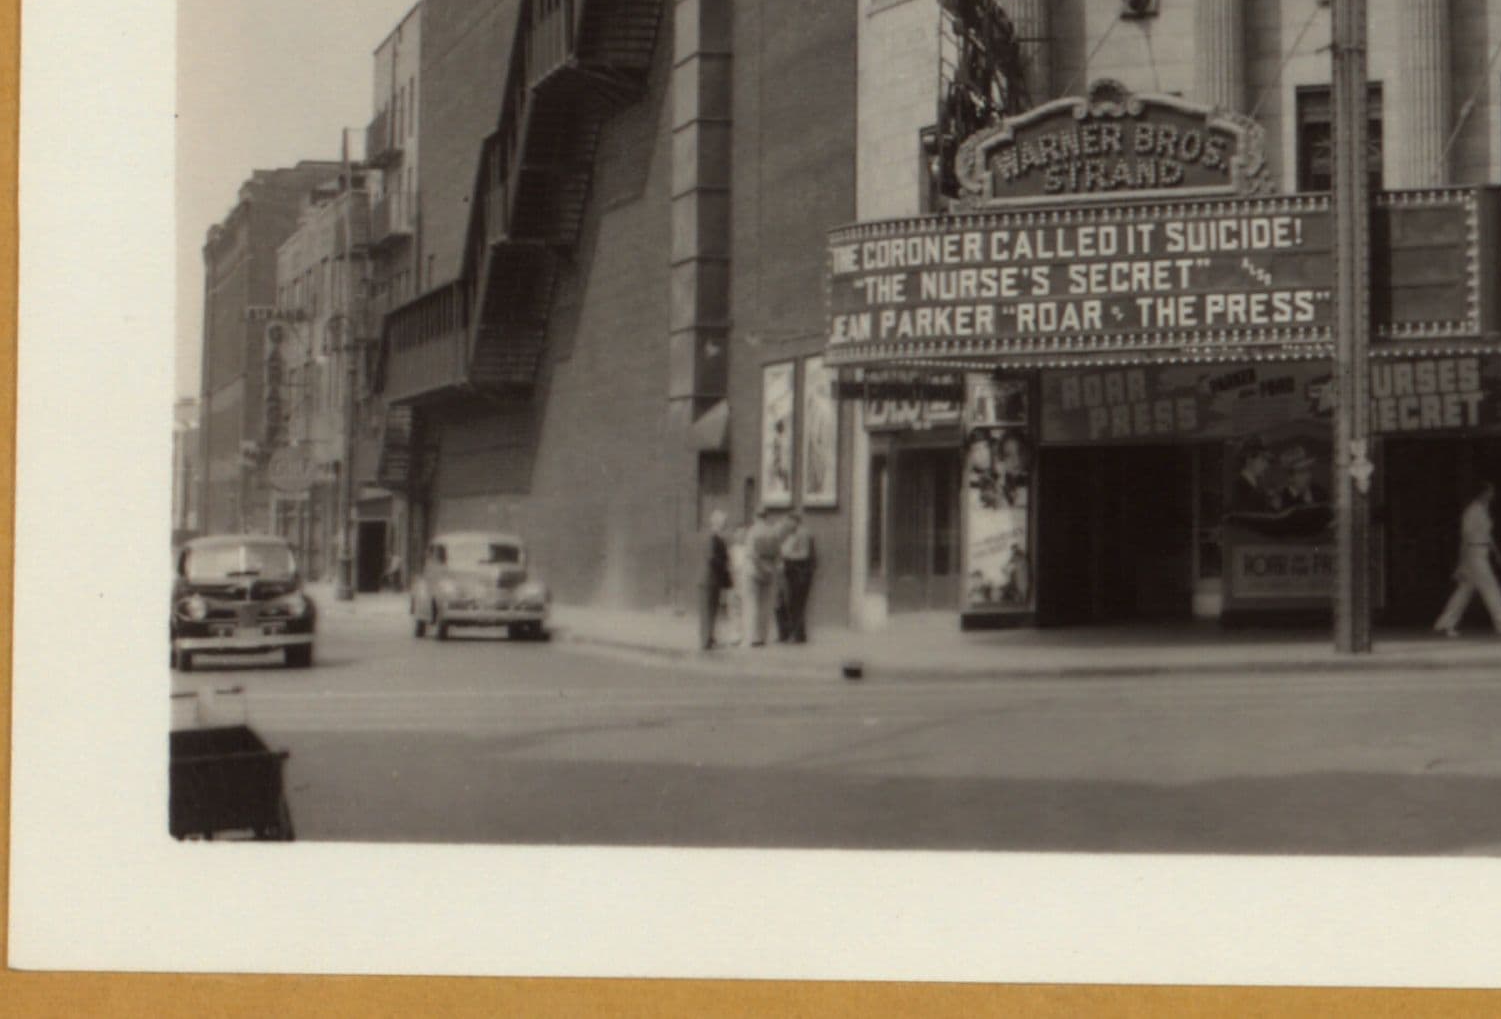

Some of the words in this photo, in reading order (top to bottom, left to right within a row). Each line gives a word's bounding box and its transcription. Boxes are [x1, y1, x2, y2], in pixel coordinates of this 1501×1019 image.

[993, 123, 1122, 179] WARNER
[1045, 159, 1182, 191] STRAND
[862, 232, 984, 270] CORONER
[990, 225, 1118, 262] CALLED
[1126, 223, 1156, 255] IT
[1165, 217, 1303, 253] SUICIDE!
[919, 265, 1050, 300] NURSE'S
[878, 304, 996, 339] PARKER
[1001, 299, 1103, 333] "ROAR
[1136, 295, 1198, 329] THE
[1204, 290, 1331, 326] PRESS"
[1371, 358, 1479, 398] URSES
[1371, 391, 1485, 432] ECRET
